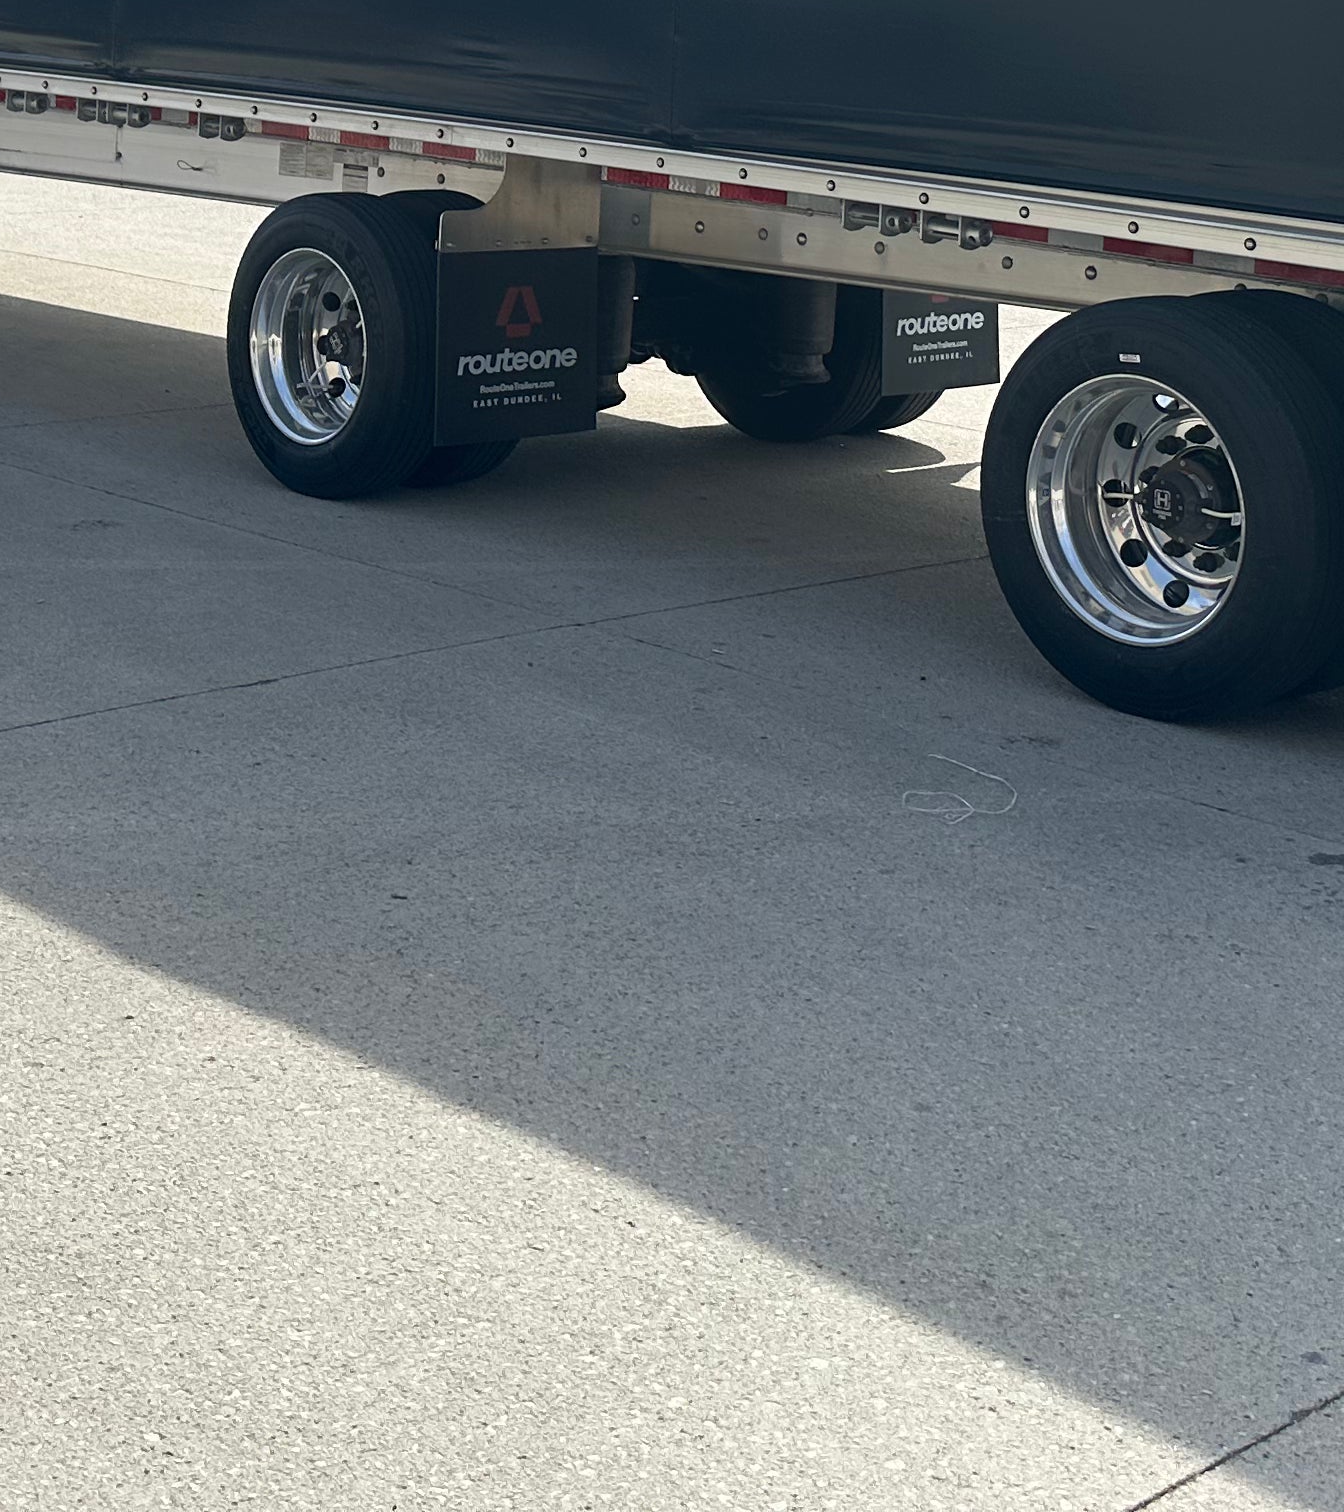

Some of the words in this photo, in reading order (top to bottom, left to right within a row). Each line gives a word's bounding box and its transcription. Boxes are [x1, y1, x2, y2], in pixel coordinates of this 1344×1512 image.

[896, 311, 985, 337] routeone
[457, 347, 578, 376] routeone
[473, 398, 499, 408] EAST
